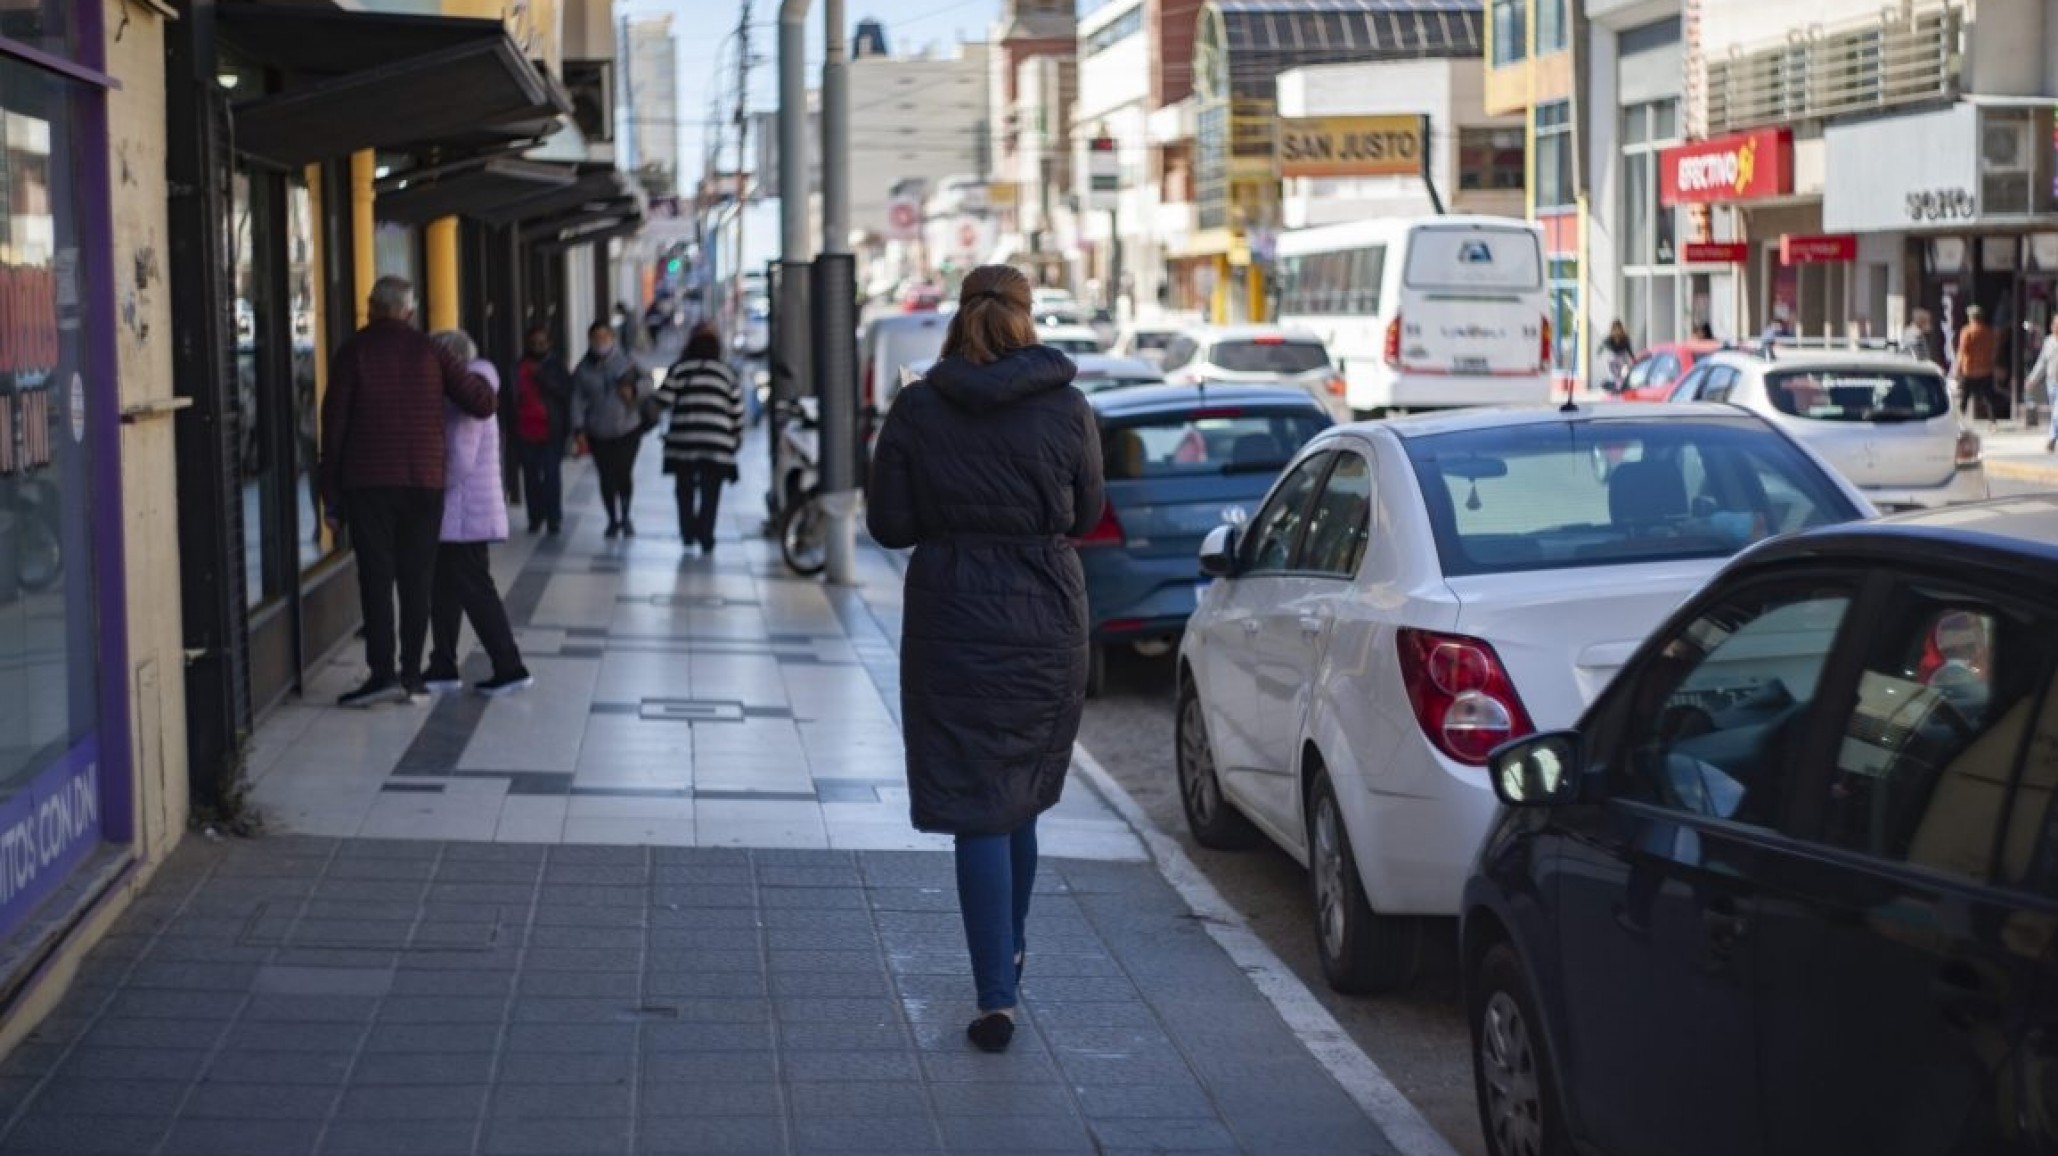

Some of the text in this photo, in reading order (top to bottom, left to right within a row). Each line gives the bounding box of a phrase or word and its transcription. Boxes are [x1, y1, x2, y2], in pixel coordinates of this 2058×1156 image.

[1282, 130, 1416, 161] SAN JUSTO
[1677, 151, 1738, 191] EFECTIVO
[0, 762, 97, 905] ITOS CON DNI
